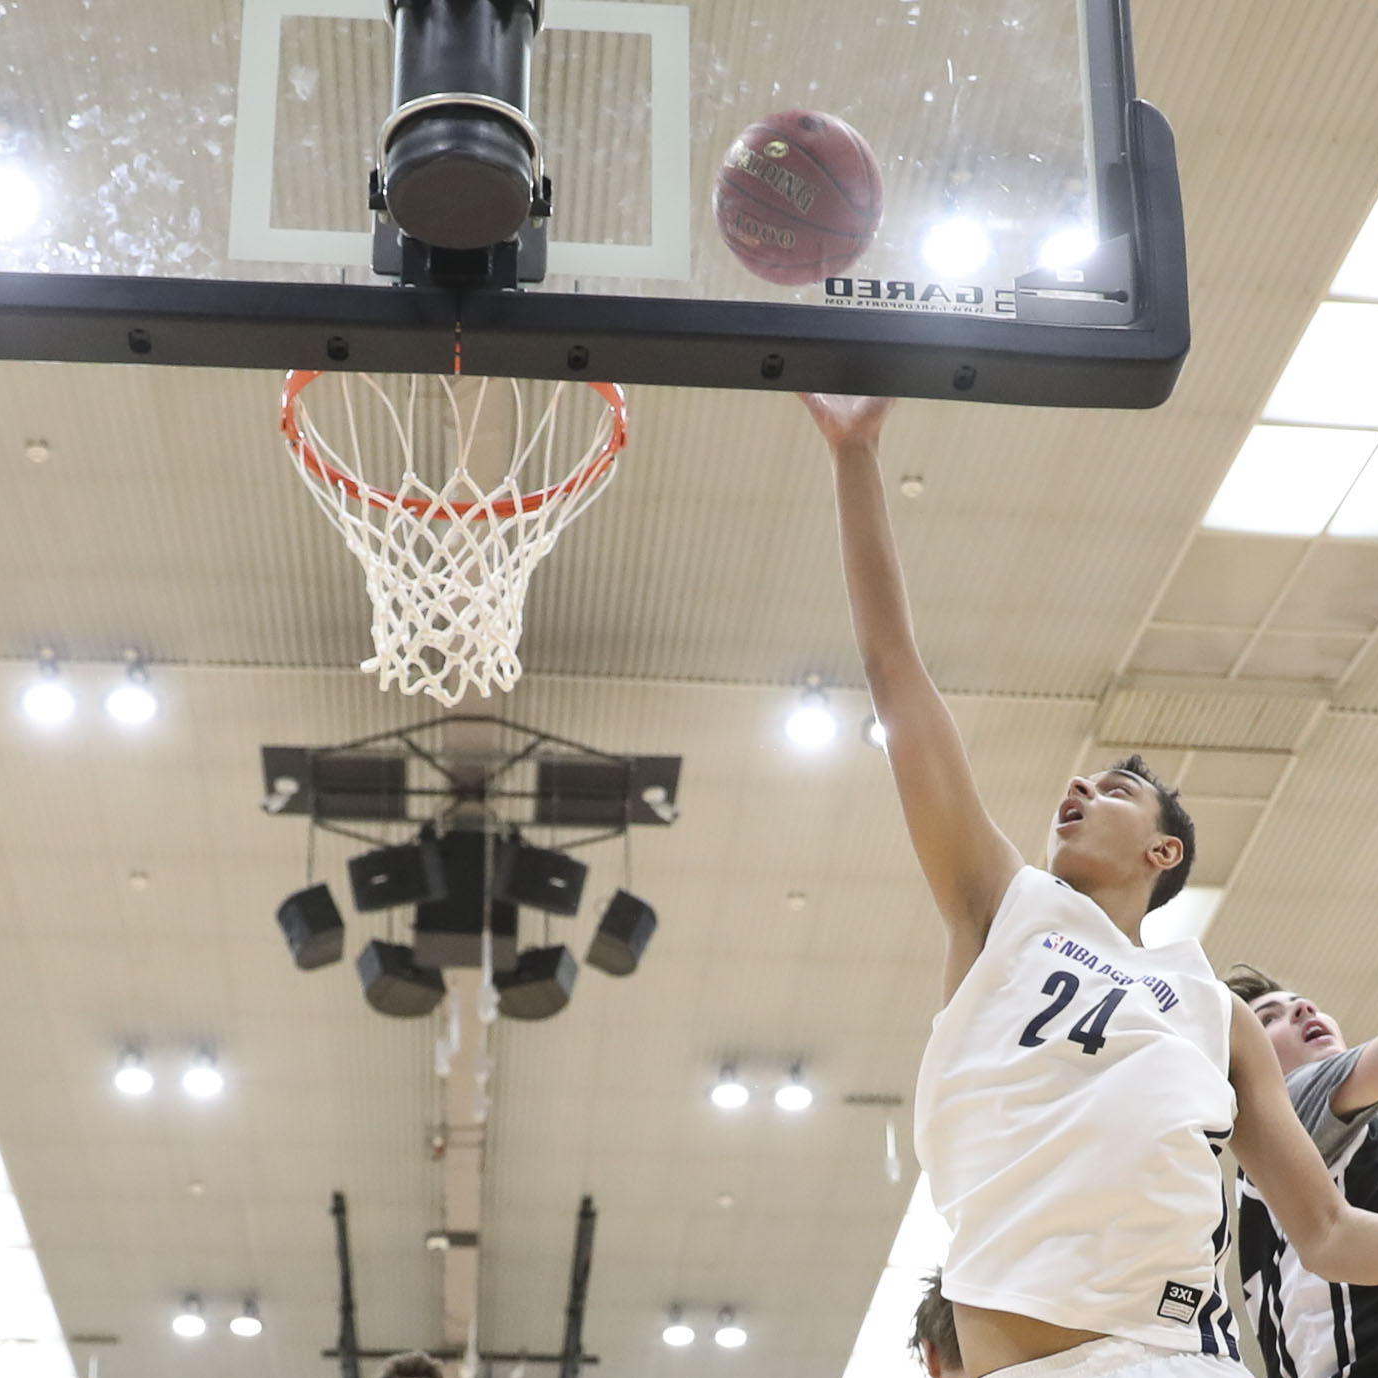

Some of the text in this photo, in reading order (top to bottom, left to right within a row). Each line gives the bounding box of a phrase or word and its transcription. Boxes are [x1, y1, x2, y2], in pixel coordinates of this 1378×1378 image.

[1018, 970, 1129, 1056] 24
[1058, 940, 1180, 1014] NBA Acaemy
[1168, 1286, 1195, 1304] 3XL
